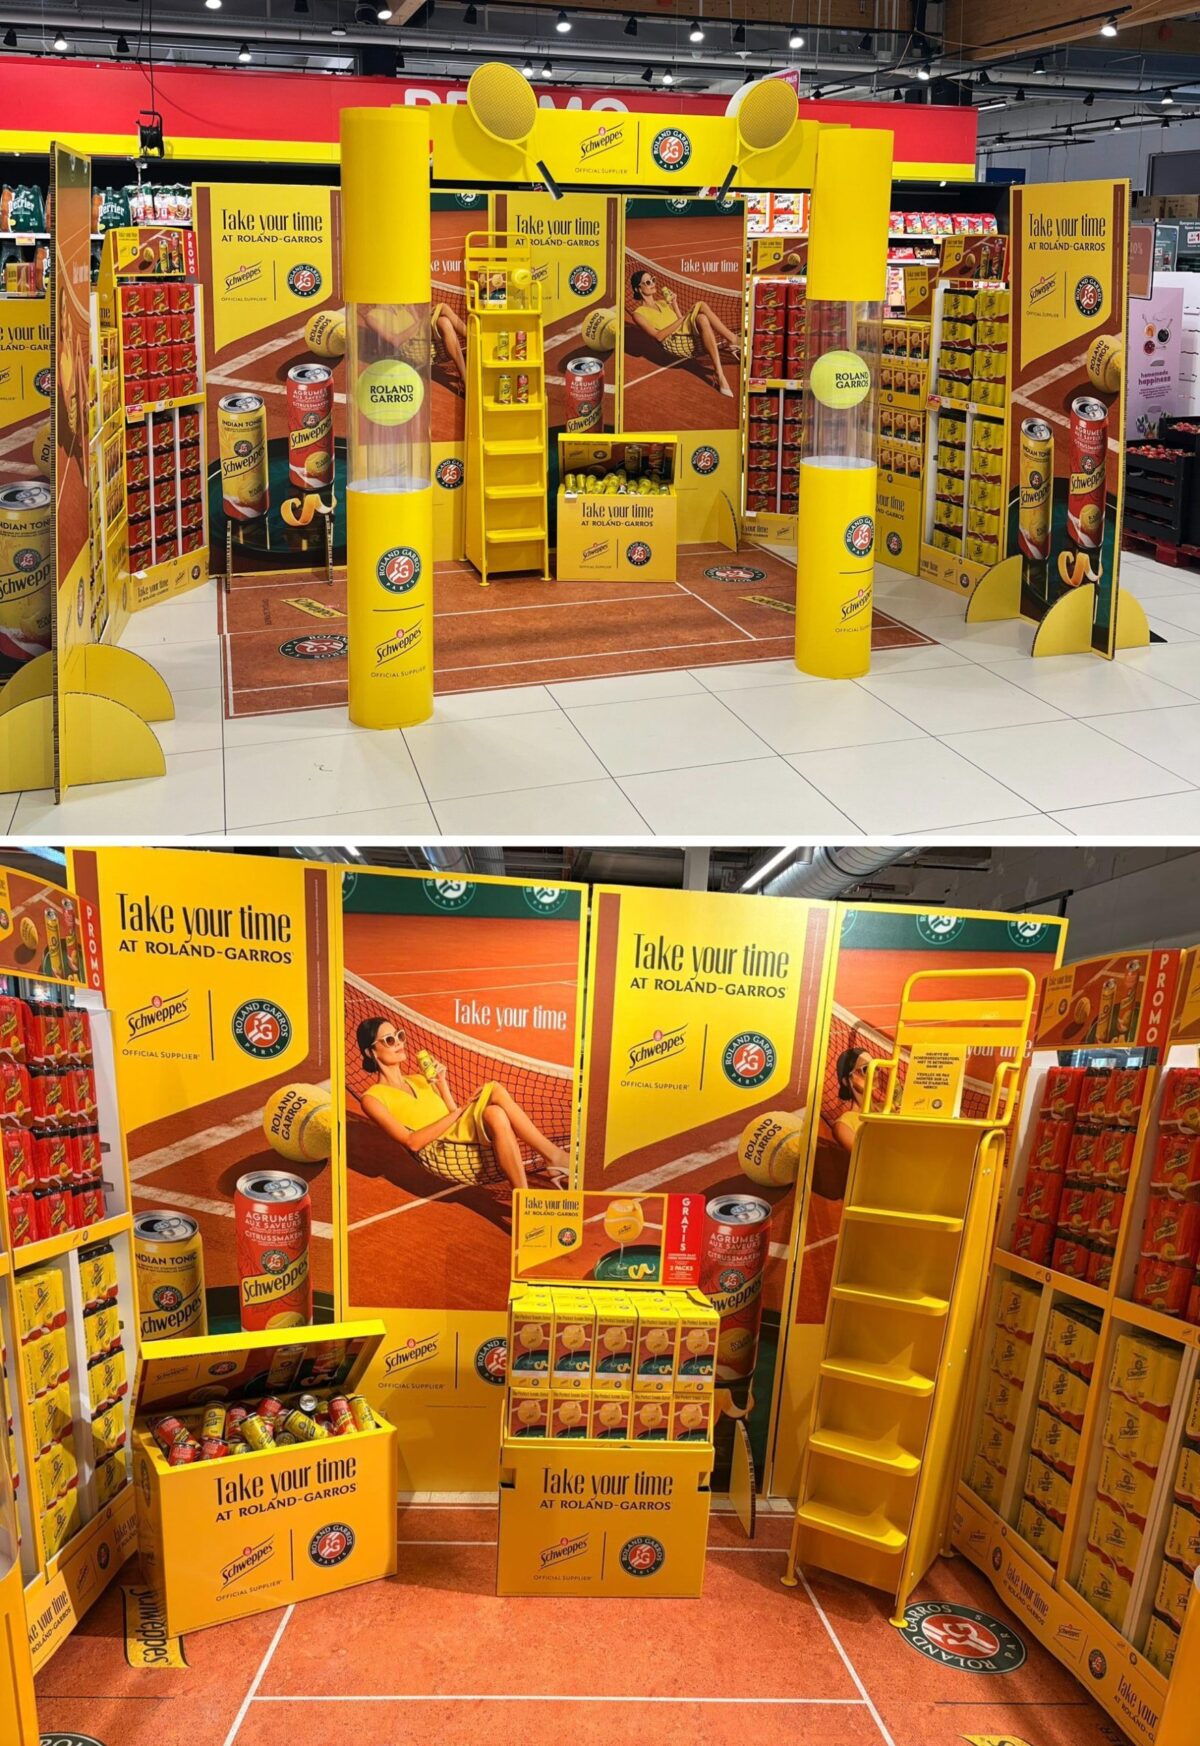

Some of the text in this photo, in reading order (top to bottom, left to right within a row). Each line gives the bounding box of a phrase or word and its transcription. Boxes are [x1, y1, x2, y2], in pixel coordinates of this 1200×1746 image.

[581, 130, 623, 158] Schweppes
[654, 130, 689, 155] ROLAND GARROS
[659, 161, 684, 170] PARIS
[221, 209, 323, 234] Take your time
[515, 215, 599, 238] Take your time
[1029, 213, 1106, 240] Take your time
[238, 235, 323, 243] ROLAND-GARROS
[1028, 241, 1105, 251] AT ROLAND-GARROS
[187, 232, 195, 275] PROMO
[441, 259, 461, 274] your
[225, 267, 261, 289] Schweppes
[289, 265, 304, 285] ROLAND
[681, 259, 738, 275] Take your time
[1030, 279, 1056, 301] Schweppes
[1076, 278, 1089, 301] ROLAND
[8, 327, 34, 344] your
[309, 315, 325, 342] ROLAND
[315, 319, 331, 345] GARROS
[585, 312, 600, 339] ROLAND
[591, 316, 604, 341] GARROS
[1090, 340, 1104, 371] ROLAND
[1095, 344, 1110, 376] GARROS
[370, 384, 414, 394] ROLAND
[835, 372, 869, 381] ROLAND
[835, 380, 869, 388] GARROS
[370, 393, 414, 403] GARROS
[582, 502, 654, 523] Take your time
[847, 519, 863, 542] ROLAND
[379, 550, 419, 576] ROLAND GARROS
[385, 579, 416, 591] PARIS
[376, 628, 422, 663] Schweppes
[116, 893, 291, 944] Take your time
[86, 905, 100, 987] PROMO
[119, 940, 292, 964] AT ROLAND-GARROS
[634, 933, 789, 980] Take your time
[630, 977, 786, 999] AT ROLAND-GARROS
[1146, 954, 1169, 1043] PROMO
[128, 999, 187, 1037] Schweppes
[236, 1002, 288, 1037] ROLAND GARROS
[454, 998, 567, 1032] Take your time
[122, 1049, 198, 1060] OFFICIAL SUPPLIER
[244, 1043, 281, 1055] PARIS
[628, 1034, 685, 1069] Schweppes
[725, 1035, 772, 1068] ROLAND GARROS
[620, 1080, 688, 1090] OFFICIAL SUPPLIER
[731, 1073, 764, 1085] PARIS
[271, 1090, 297, 1135] ROLAND
[281, 1096, 308, 1141] GARROS
[744, 1117, 774, 1161] ROLAND
[753, 1123, 783, 1167] GARROS
[246, 1211, 300, 1222] AGRUMES
[525, 1197, 579, 1211] Take your time
[680, 1197, 691, 1251] GRATIS
[385, 1341, 437, 1373] Schweppes
[478, 1340, 500, 1366] ROLAND
[214, 1456, 357, 1506] Take your time
[543, 1467, 673, 1500] Take your time
[215, 1484, 357, 1523] AT ROLAND-GARROS
[540, 1500, 671, 1510] AT ROLAND-GARROS
[310, 1525, 353, 1554] ROLAND GARROS
[622, 1539, 663, 1561] ROLAND GARROS
[222, 1542, 273, 1585] Schweppes
[540, 1540, 587, 1566] Schweppes
[216, 1581, 281, 1602] OFFICIAL SUPPLIER
[1006, 1561, 1020, 1585] Take
[1033, 1592, 1049, 1616] time
[38, 1590, 69, 1637] your time
[906, 1605, 997, 1670] ROLAND GARROS
[975, 1614, 1016, 1658] PARIS
[1117, 1674, 1159, 1729] Take your
